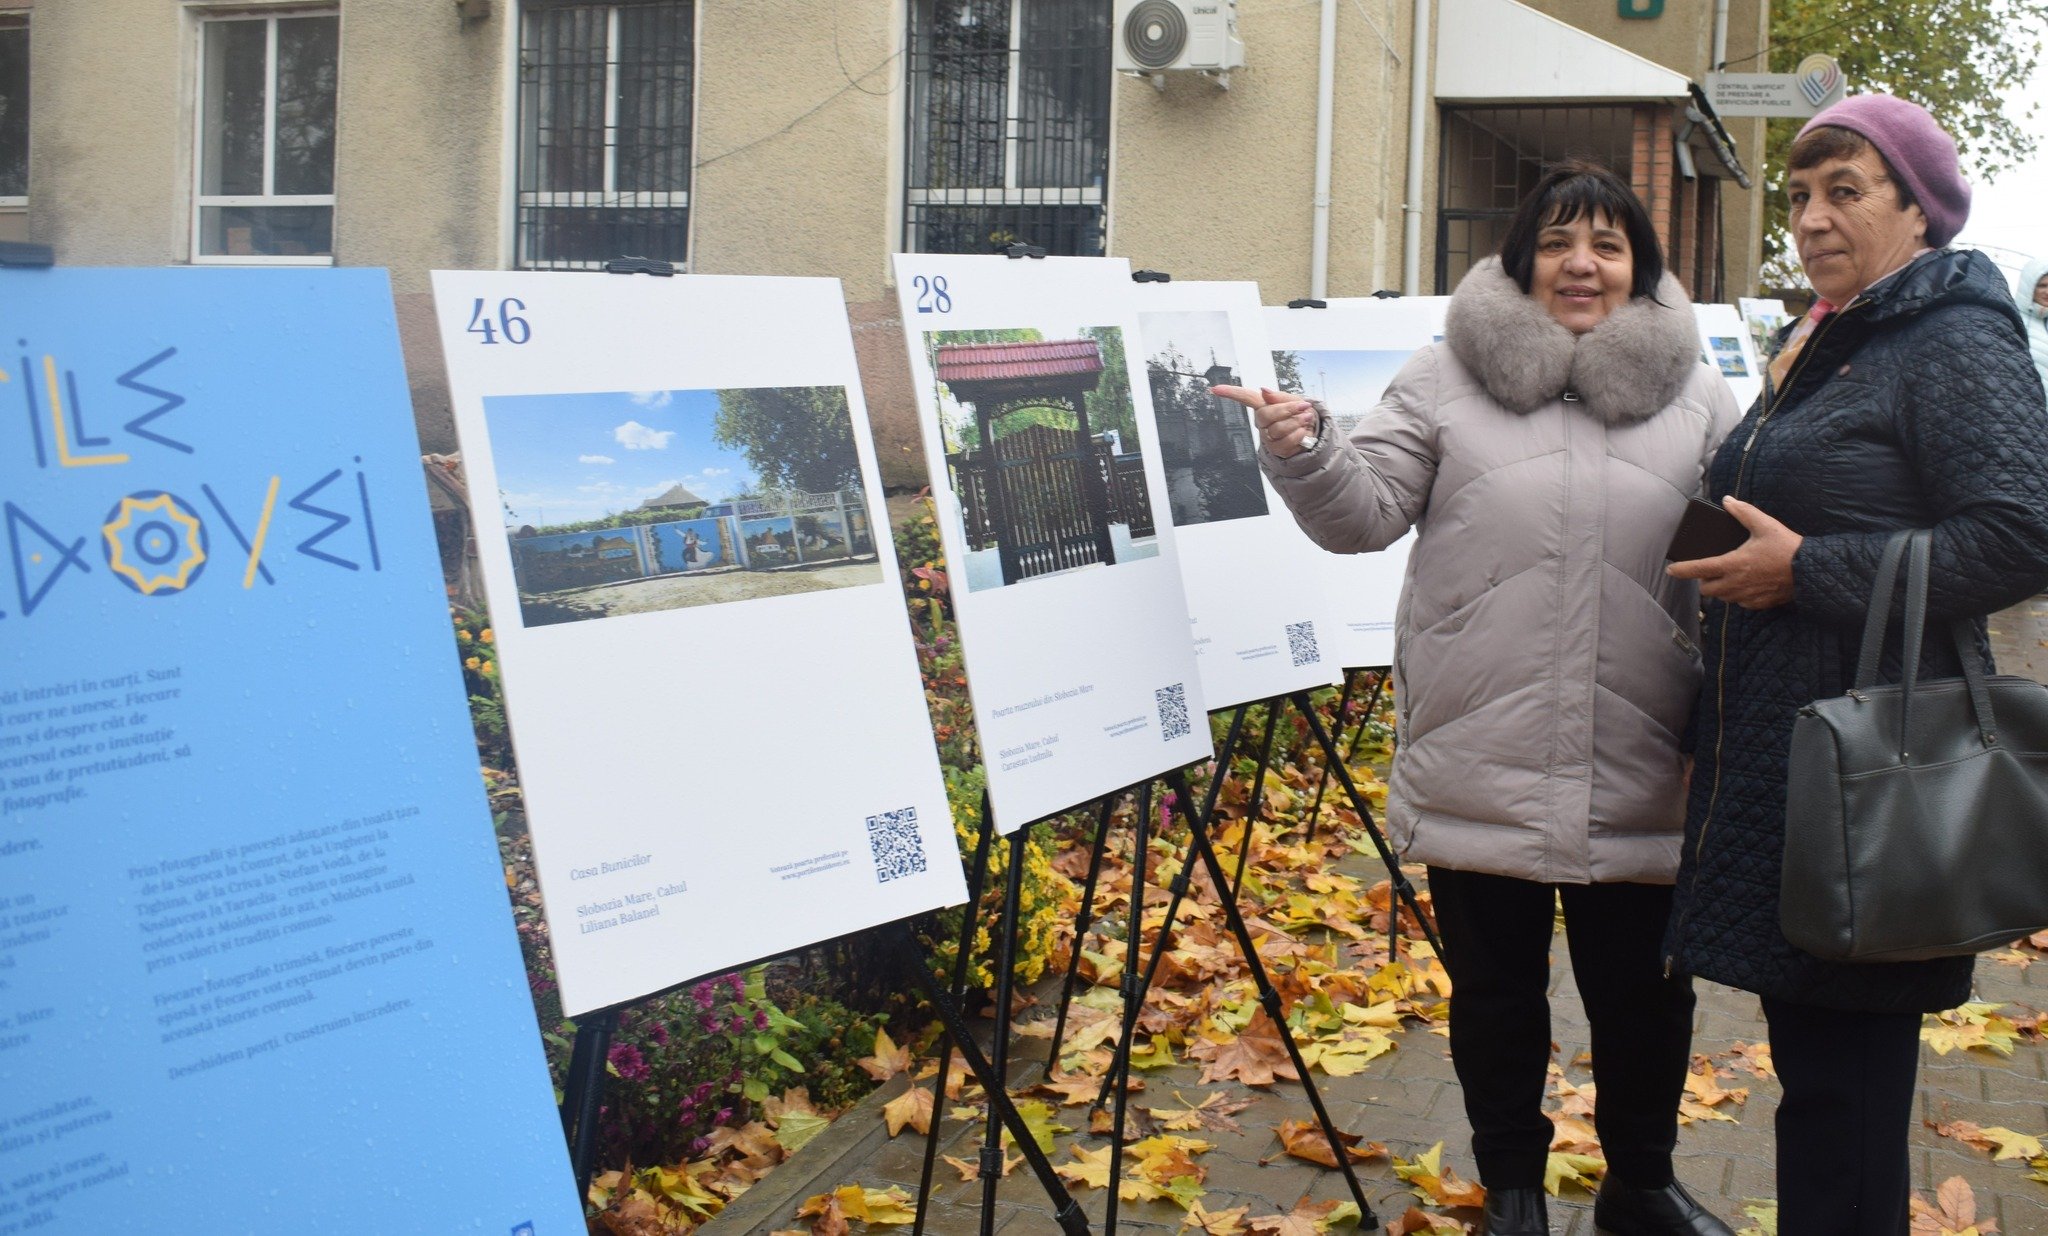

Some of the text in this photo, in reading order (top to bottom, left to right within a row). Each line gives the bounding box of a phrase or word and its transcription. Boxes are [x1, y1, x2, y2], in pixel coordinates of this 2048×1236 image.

[913, 275, 952, 314] 28
[466, 296, 531, 345] 46
[146, 667, 182, 682] Sunt
[7, 710, 44, 726] care
[48, 706, 67, 720] ne
[125, 688, 182, 707] Fiecare
[991, 706, 1014, 720] Poarta
[1054, 688, 1079, 702] Slobozia
[1079, 684, 1095, 695] Mare
[42, 725, 98, 741] despre
[129, 712, 148, 726] de
[60, 743, 92, 760] este
[95, 742, 106, 753] o
[999, 746, 1026, 760] Slobozia
[1042, 733, 1060, 746] Cahul
[10, 773, 41, 790] sau
[44, 768, 64, 783] de
[2, 785, 89, 816] fotografie.
[128, 865, 159, 881] Prin
[159, 848, 223, 875] fotografii
[340, 817, 361, 832] din
[362, 809, 395, 827] toată
[141, 881, 159, 897] de
[161, 877, 175, 892] la
[176, 868, 223, 888] Soroca
[224, 862, 238, 877] la
[293, 846, 310, 861] de
[310, 843, 323, 857] la
[324, 830, 376, 852] Ungheni
[376, 828, 389, 842] la
[194, 888, 211, 903] de
[211, 884, 227, 898] la
[262, 872, 277, 886] la
[357, 849, 372, 863] de
[373, 845, 387, 859] la
[570, 853, 653, 881] Casa Bunicilor
[138, 909, 208, 933] Naslavcea
[208, 903, 223, 918] la
[329, 876, 339, 888] o
[339, 864, 388, 885] imagine
[206, 926, 216, 938] a
[218, 909, 277, 933] Moldovei
[278, 903, 296, 919] de
[320, 896, 330, 908] o
[330, 881, 382, 903] Moldovă
[577, 880, 688, 918] Slobozia Mare, Cahul
[580, 904, 660, 935] Liliana Balanel
[146, 955, 177, 975] prin
[178, 942, 219, 962] valori
[152, 984, 205, 1008] Fiecare
[206, 964, 272, 993] fotografie
[325, 939, 369, 960] fiecare
[369, 927, 416, 951] poveste
[214, 987, 260, 1010] fiecare
[262, 979, 284, 995] vot
[284, 963, 343, 988] exprimat
[344, 953, 380, 972] devin
[380, 944, 414, 966] parte
[413, 938, 435, 953] din
[160, 1016, 215, 1045] această
[215, 1005, 260, 1028] istorie
[168, 1048, 245, 1081] Deschidem
[284, 1016, 352, 1045] Construim
